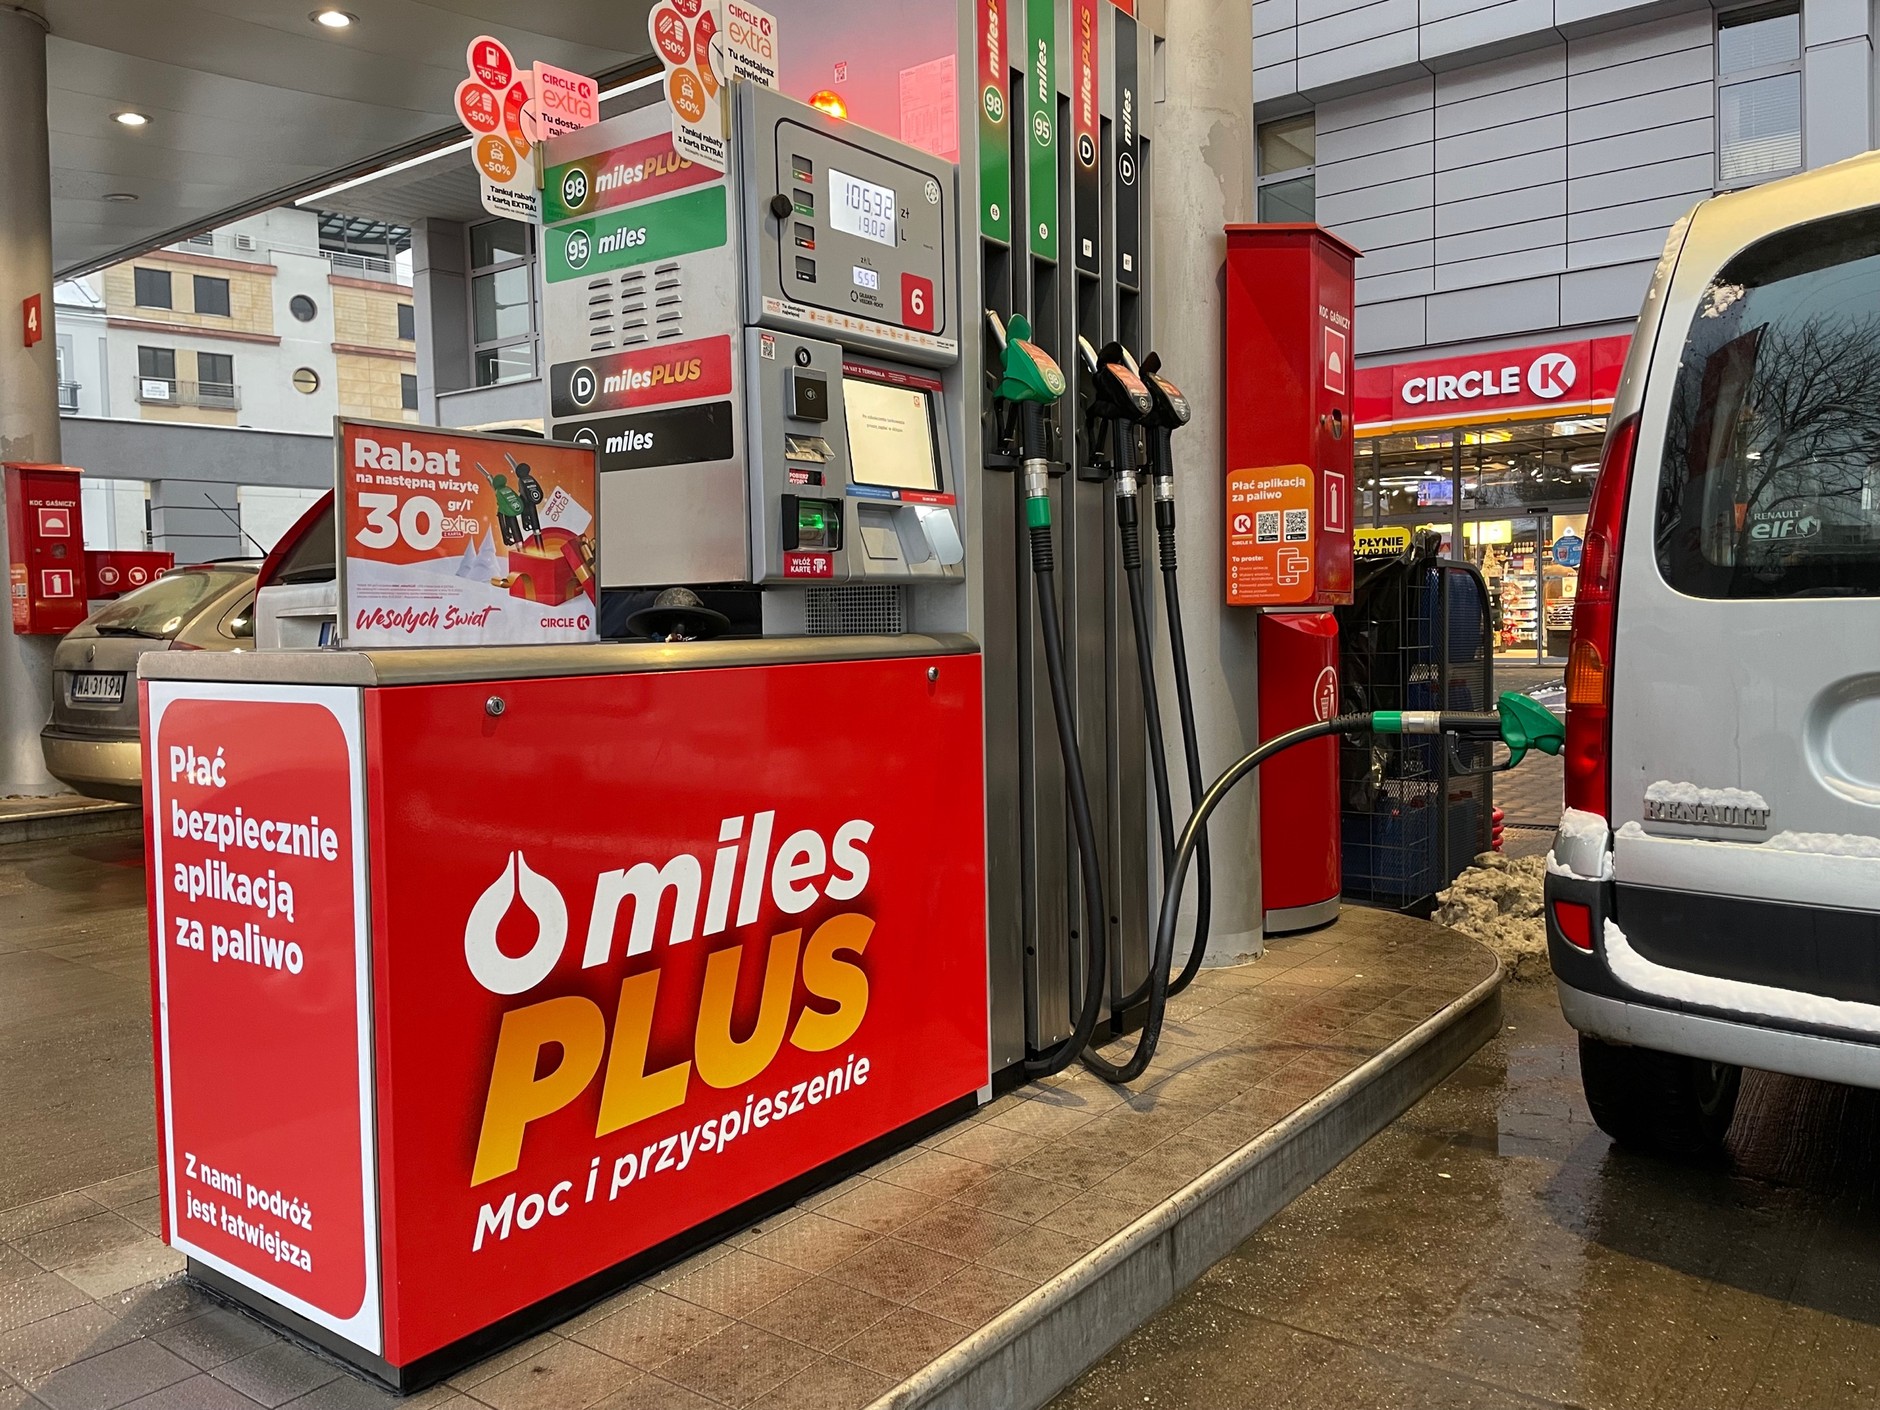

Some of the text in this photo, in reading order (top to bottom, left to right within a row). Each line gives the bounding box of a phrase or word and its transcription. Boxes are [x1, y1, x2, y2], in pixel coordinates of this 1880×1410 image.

[729, 4, 758, 27] CIRCLE
[760, 18, 771, 36] K
[662, 39, 686, 58] -50%
[729, 22, 772, 59] extra
[728, 47, 738, 60] Tu
[740, 54, 774, 78] dostajesz
[1036, 38, 1048, 104] miles
[479, 70, 507, 85] -10 -15
[542, 73, 591, 98] CIRCLE K
[544, 89, 592, 119] extra
[677, 99, 700, 116] -50%
[986, 93, 1001, 116] 98
[468, 110, 494, 126] -50%
[541, 112, 553, 124] Tu
[1034, 118, 1049, 139] 95
[1123, 87, 1132, 146] miles
[681, 124, 723, 148] Tankuj rabaty
[683, 136, 700, 150] kartą
[700, 144, 723, 158] EXTRA!
[1082, 141, 1091, 159] D
[485, 161, 511, 176] -50%
[1123, 160, 1132, 177] D
[490, 186, 536, 203] Tankuj rabaty
[565, 177, 584, 200] 98
[492, 196, 510, 207] kartą
[568, 227, 647, 261] 95 miles
[902, 228, 906, 241] L
[912, 288, 924, 315] 6
[28, 306, 37, 332] 4
[1319, 304, 1350, 330] KOC GAŚNICZY
[577, 358, 702, 396] D milesPLUS
[1402, 355, 1576, 404] CIRCLE K
[605, 430, 654, 454] miles
[354, 438, 460, 476] Rabat
[356, 474, 479, 494] na następną wizytę
[1232, 476, 1306, 490] Płać aplikacją
[46, 499, 76, 507] GAŚNICZY
[1232, 491, 1282, 502] za paliwo
[551, 496, 569, 522] extra
[1754, 510, 1800, 520] RENAULT
[355, 492, 444, 551] 30
[441, 515, 478, 534] extra
[1236, 516, 1250, 532] K
[1752, 520, 1793, 538] elf
[1359, 536, 1403, 548] PŁYNIE
[791, 565, 810, 574] KARTĘ
[792, 557, 810, 566] WŁÓŻ
[540, 615, 590, 630] CIRCLE K
[169, 745, 226, 789] Płać
[1644, 800, 1770, 826] RENAULT
[171, 799, 338, 862] bezpiecznie
[173, 858, 294, 924] aplikacją
[582, 810, 875, 969] miles
[175, 918, 303, 975] za paliwo
[470, 912, 877, 1188] PLUS
[472, 1054, 871, 1252] Moc i przyspieszenie
[184, 1152, 313, 1232] Z nami podróż
[186, 1189, 312, 1273] jest łatwiejsza
